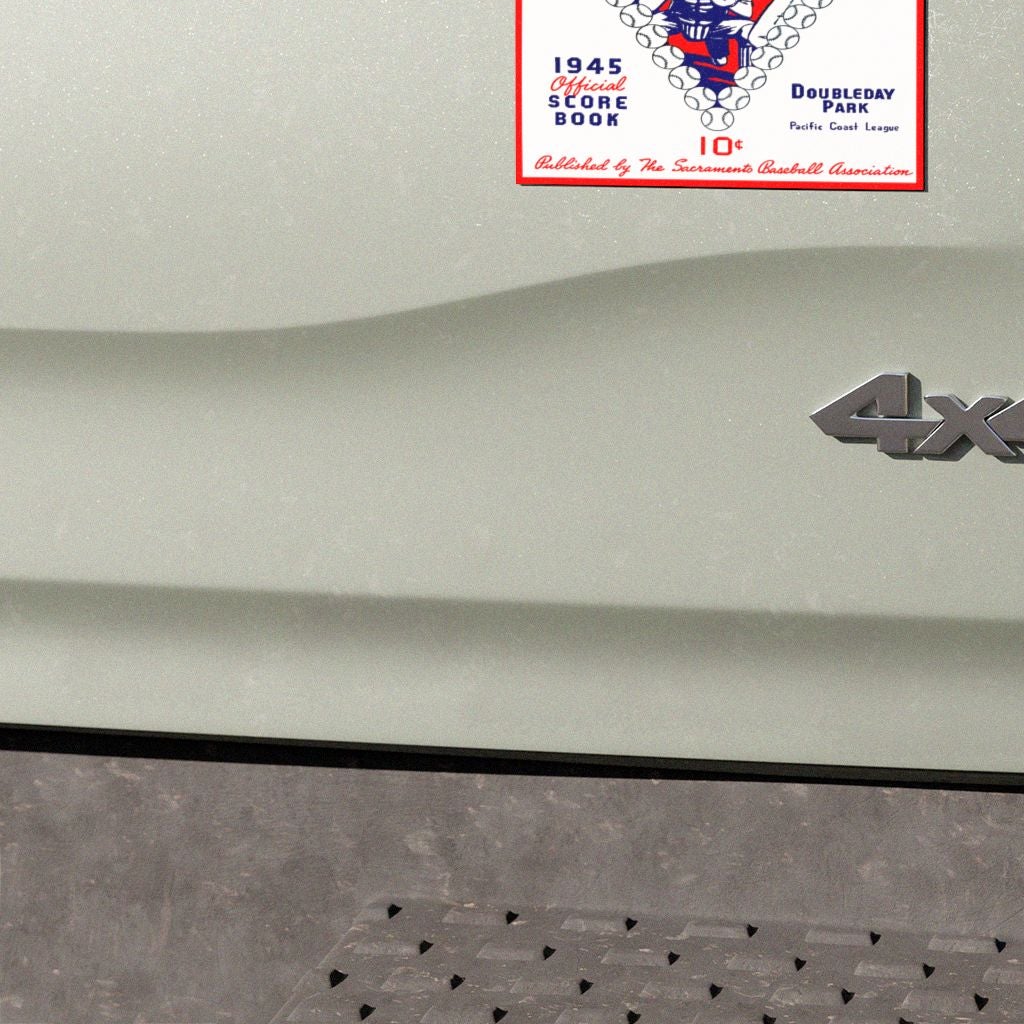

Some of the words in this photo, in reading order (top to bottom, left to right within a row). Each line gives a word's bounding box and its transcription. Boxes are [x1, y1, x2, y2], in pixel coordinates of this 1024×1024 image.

[554, 56, 622, 75] 1945
[550, 75, 627, 97] Official
[791, 82, 896, 100] DOUBLEDAY
[548, 94, 628, 110] SCORE
[822, 99, 870, 114] PARK
[554, 111, 620, 127] BOOK
[789, 120, 823, 131] Pacific
[829, 121, 858, 131] Coast
[865, 121, 900, 133] League
[699, 136, 743, 156] 10¢
[534, 154, 610, 171] Published
[613, 158, 631, 178] by
[639, 158, 664, 173] The
[671, 158, 753, 174] Sacramento
[757, 159, 824, 175] Baseball
[828, 161, 913, 177] Association
